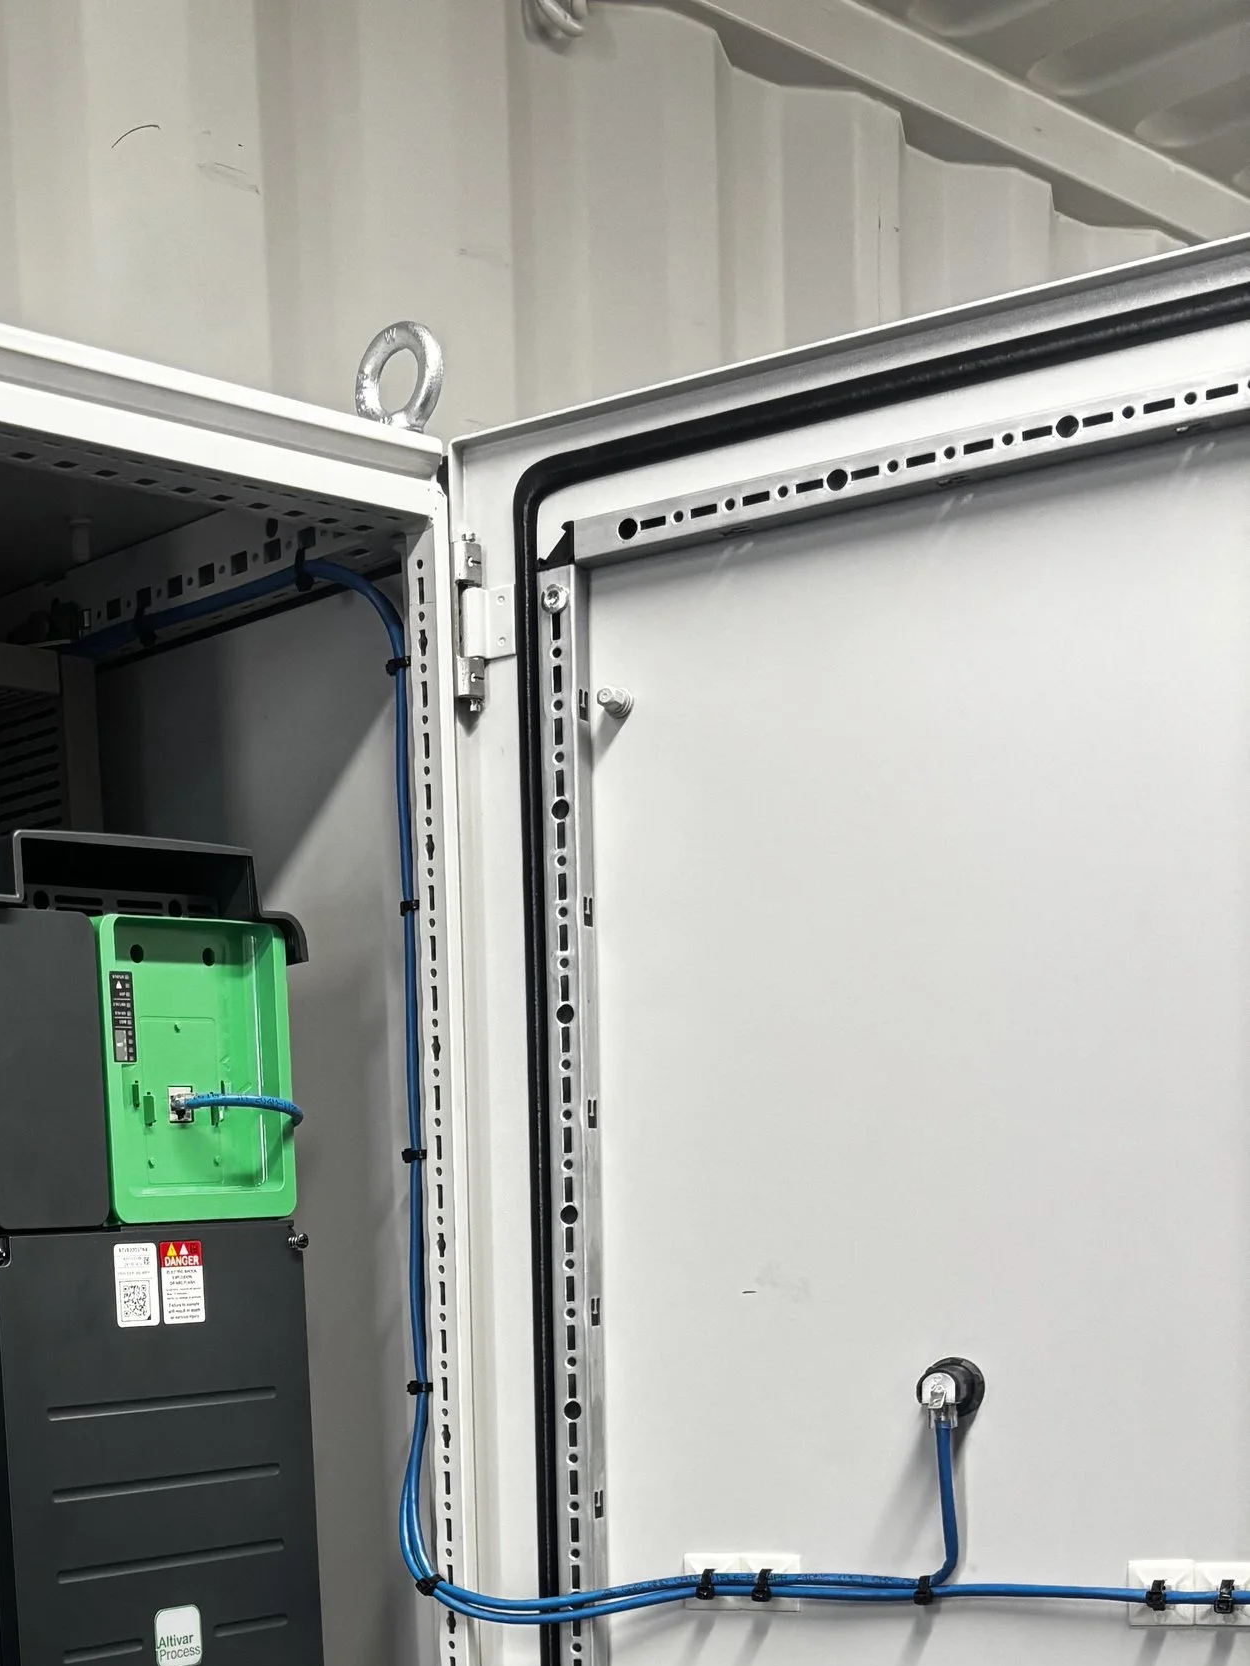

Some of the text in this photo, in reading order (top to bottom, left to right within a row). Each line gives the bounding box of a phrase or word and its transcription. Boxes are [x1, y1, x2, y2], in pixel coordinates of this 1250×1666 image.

[164, 1255, 200, 1267] DANGER
[158, 1633, 194, 1649] Altivar
[160, 1645, 201, 1661] Process
